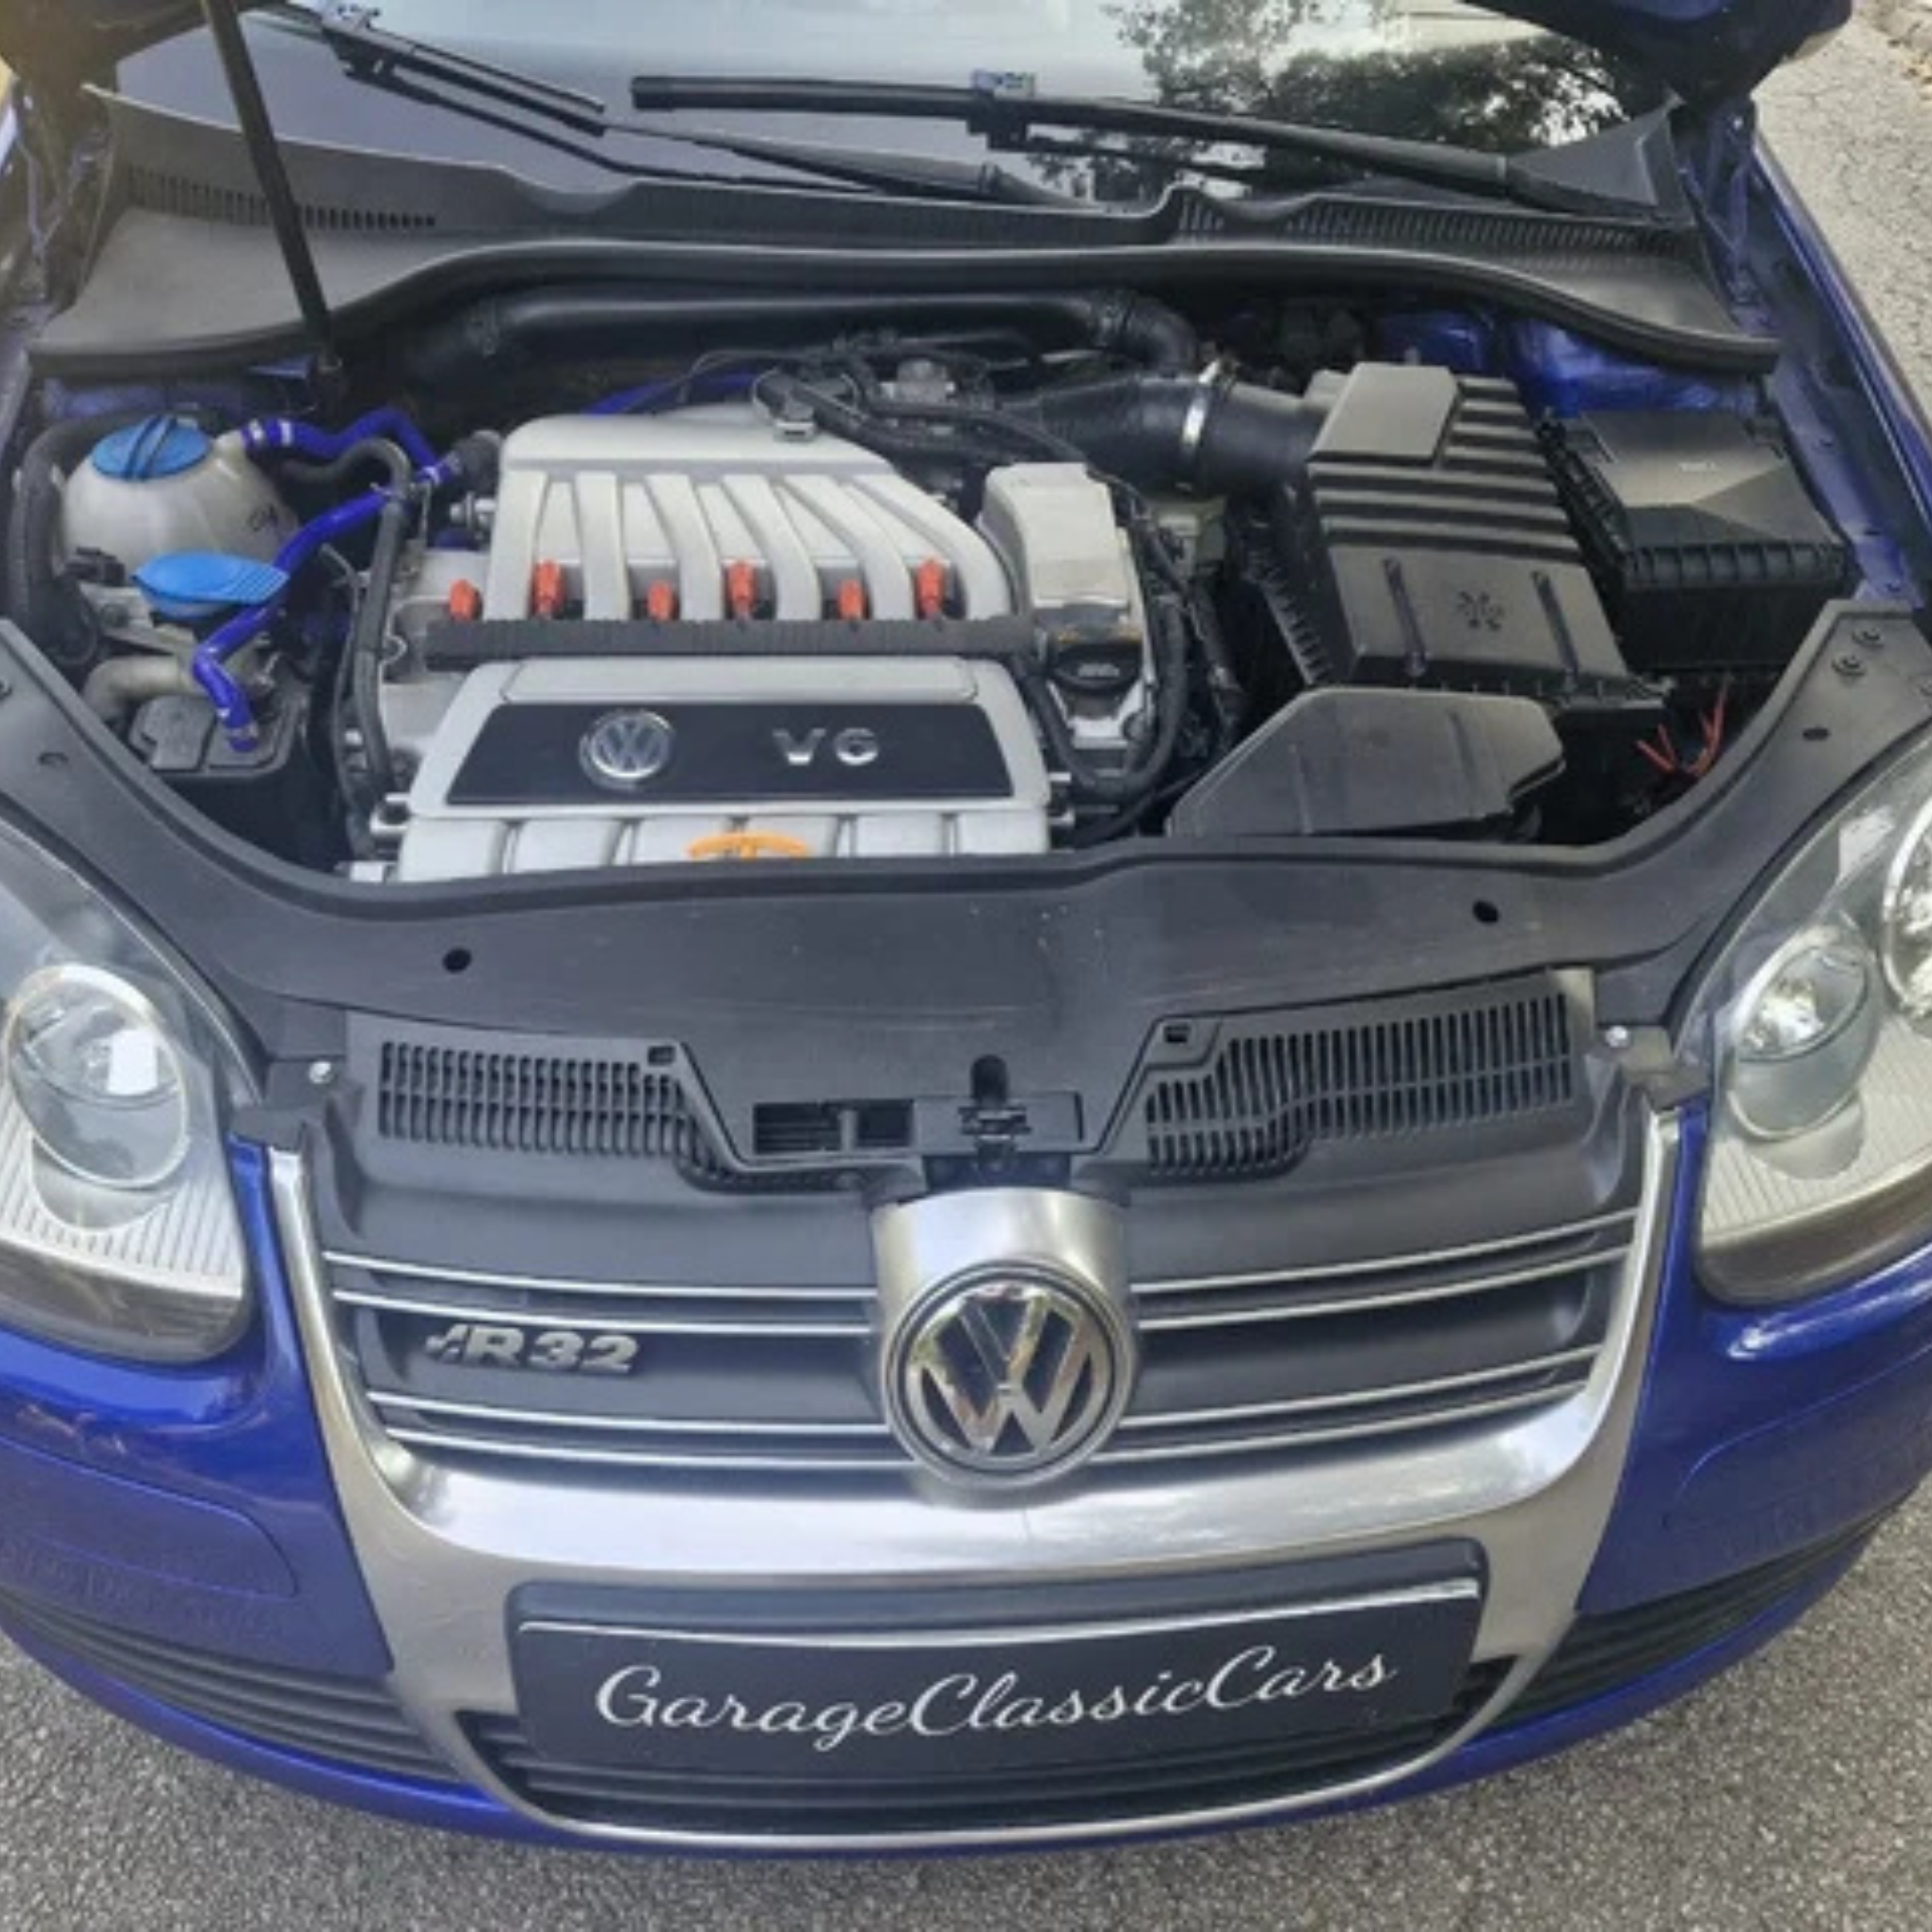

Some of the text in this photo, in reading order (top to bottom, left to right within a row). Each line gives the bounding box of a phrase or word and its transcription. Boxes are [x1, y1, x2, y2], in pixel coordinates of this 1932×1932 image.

[773, 727, 879, 766] V6
[464, 1325, 639, 1374] R32
[907, 1283, 1111, 1463] VW
[594, 1644, 1398, 1752] GarageClassicCars
